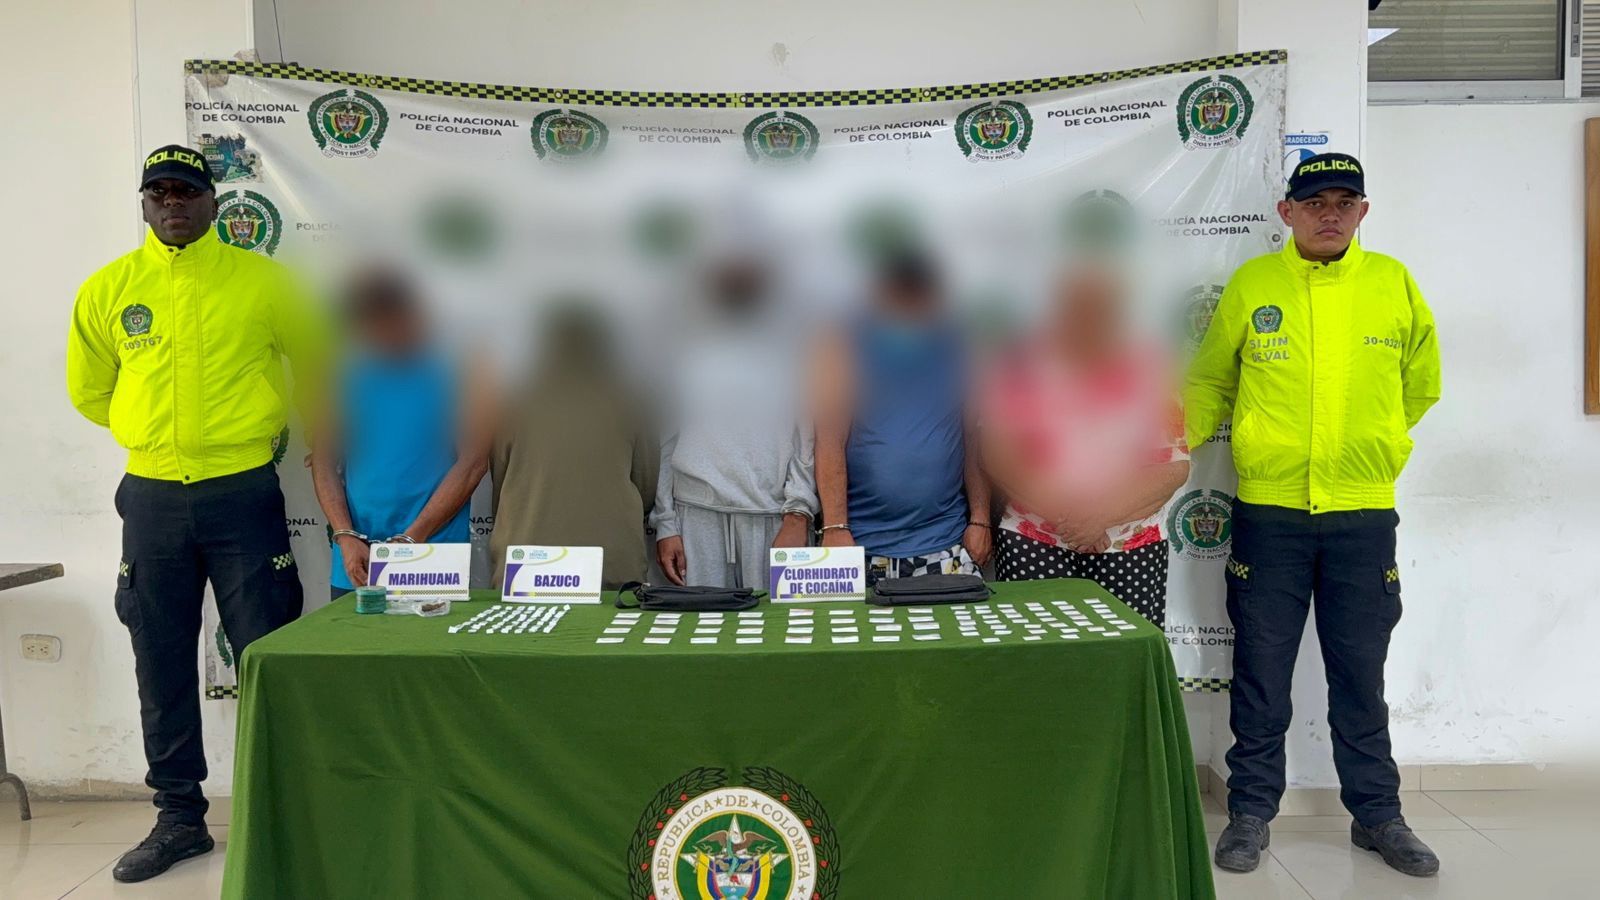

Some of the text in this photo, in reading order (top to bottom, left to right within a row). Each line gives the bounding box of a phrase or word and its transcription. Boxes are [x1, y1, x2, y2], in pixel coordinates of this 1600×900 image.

[1227, 84, 1244, 114] COLOMBIA
[185, 101, 300, 112] POLICÍA NACIONAL
[1047, 100, 1167, 118] POLICÍA NACIONAL
[202, 114, 286, 123] DE COLOMBIA
[399, 113, 519, 127] POLICÍA NACIONAL
[1064, 112, 1151, 127] DE COLOMBIA
[415, 123, 502, 136] DE COLOMBIA
[622, 125, 736, 135] POLICÍA NACIONAL
[833, 119, 947, 134] POLICÍA NACIONAL
[638, 134, 722, 144] DE COLOMBIA
[849, 131, 932, 142] DE COLOMBIA
[145, 151, 204, 172] POLICÍA
[1299, 159, 1360, 176] POLICÍA
[1200, 213, 1267, 224] NACIONAL
[1183, 225, 1250, 236] COLOMBIA
[1249, 337, 1288, 349] SIJIN
[388, 573, 460, 585] MARIHUANA
[784, 567, 858, 580] CLORHIDRATO
[534, 575, 580, 587] BAZUCO
[789, 580, 854, 594] DE COCAÍNA
[1199, 626, 1236, 635] NACIO
[1182, 637, 1235, 646] COLOMB
[657, 795, 810, 881] REPUBLICA DE COLOMBIA
